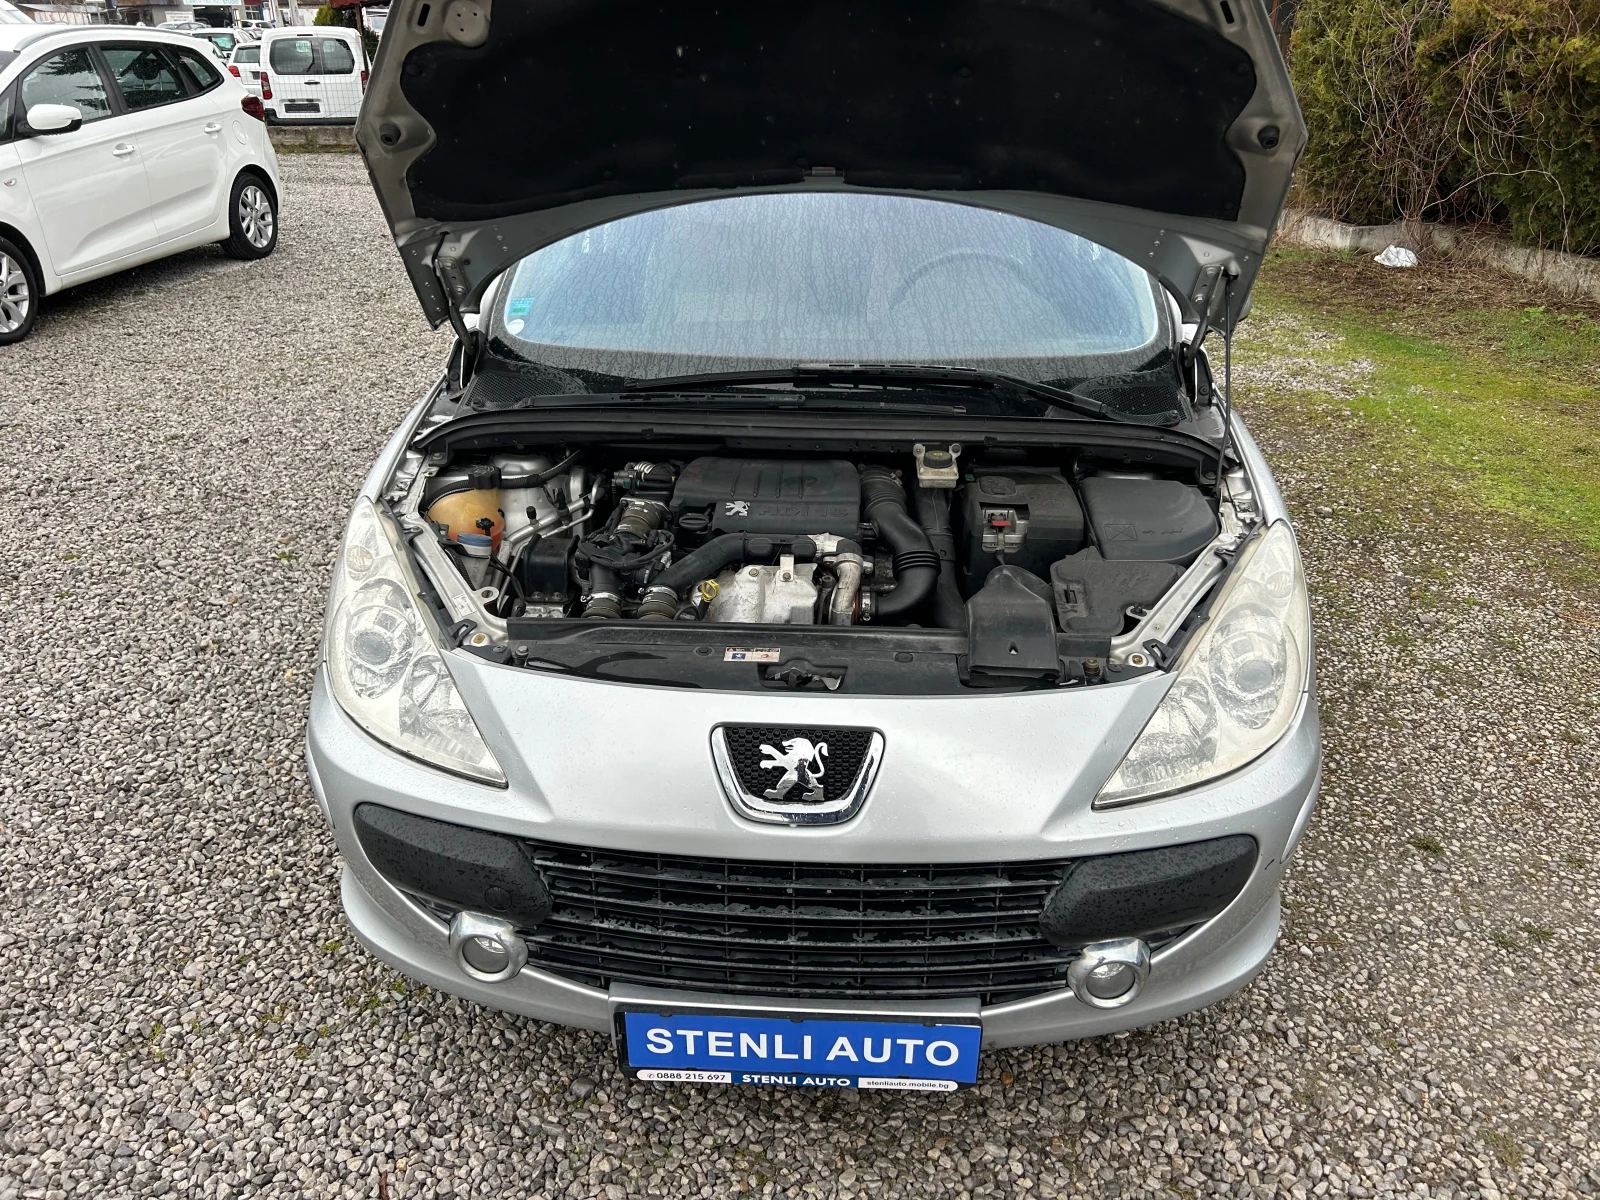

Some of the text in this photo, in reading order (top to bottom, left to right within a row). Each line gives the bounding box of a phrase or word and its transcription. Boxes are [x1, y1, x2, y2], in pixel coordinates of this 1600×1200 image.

[646, 1027, 959, 1067] STENLI AUTO
[742, 1074, 851, 1087] STENLI AUTO
[866, 1080, 949, 1089] stenliauto.mobile.bg
